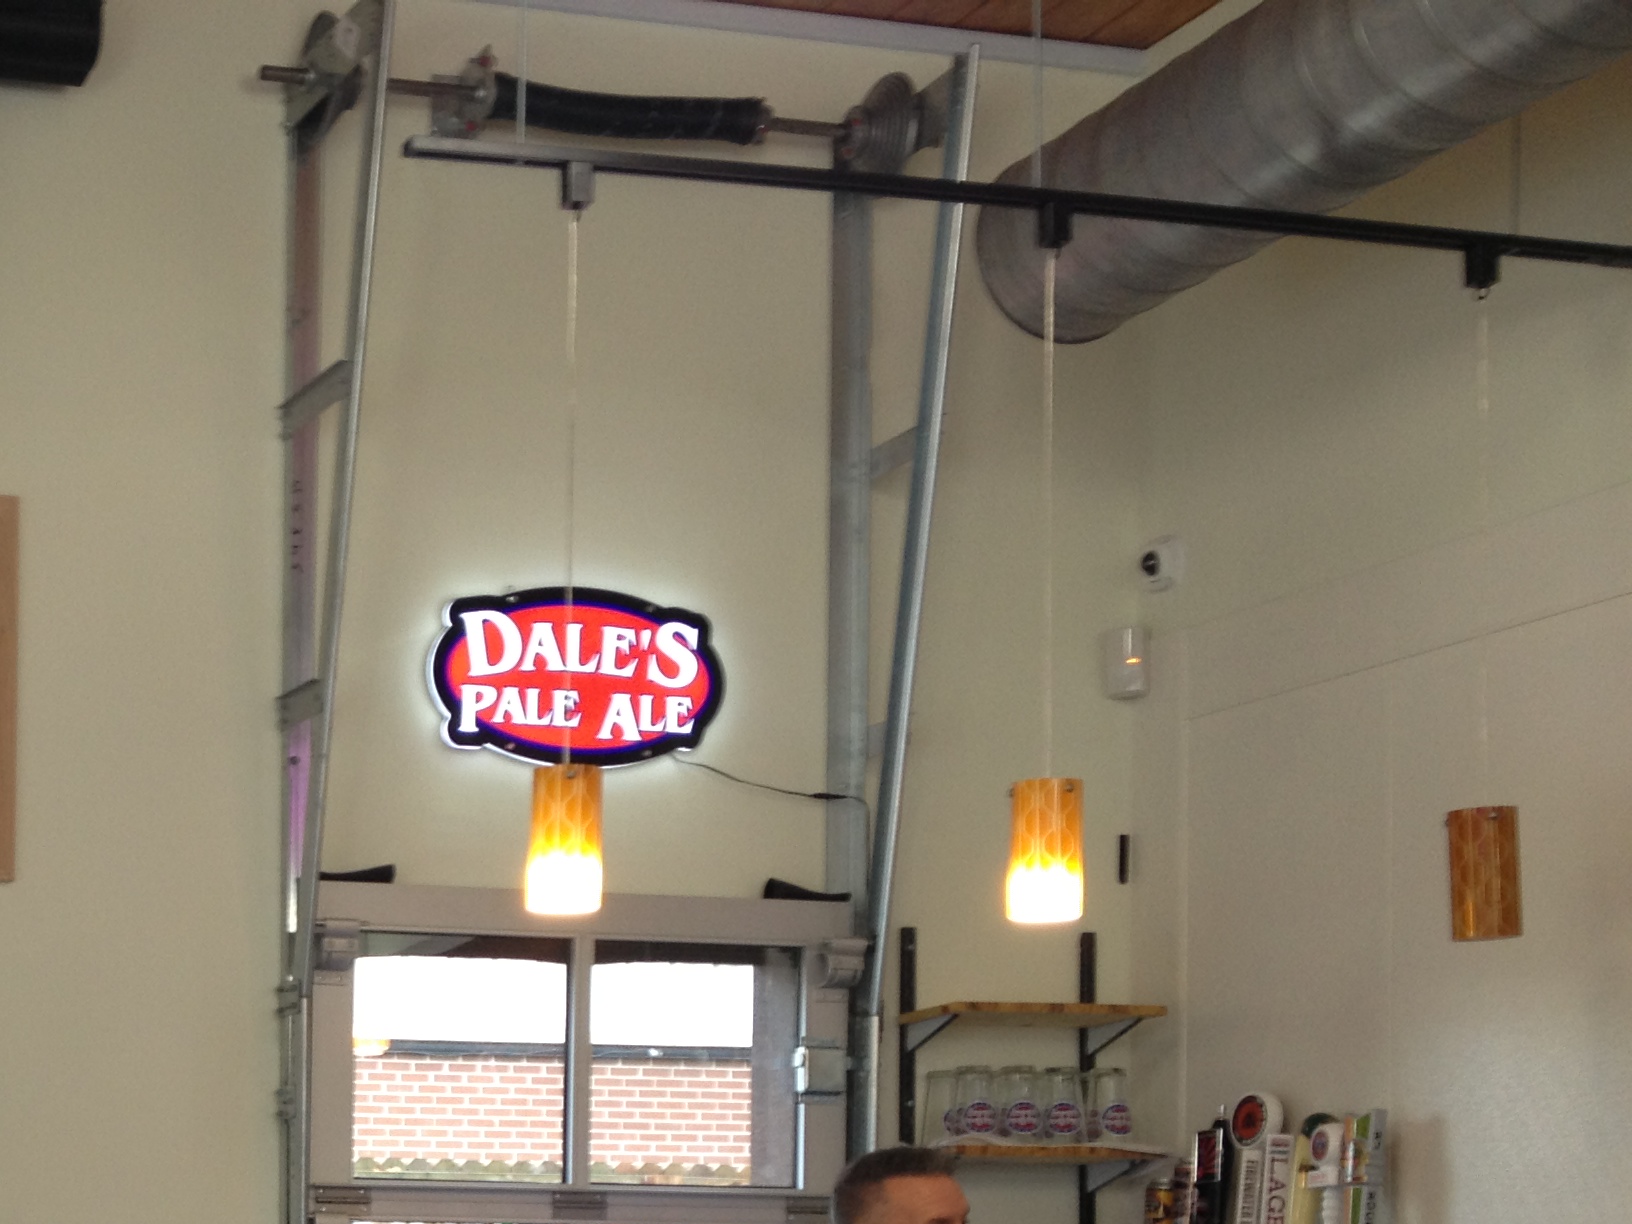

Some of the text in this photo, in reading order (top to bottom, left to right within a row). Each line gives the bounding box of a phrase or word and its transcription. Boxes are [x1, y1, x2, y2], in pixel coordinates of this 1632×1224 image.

[459, 609, 699, 689] DALE'S
[458, 683, 695, 742] PALE ALE
